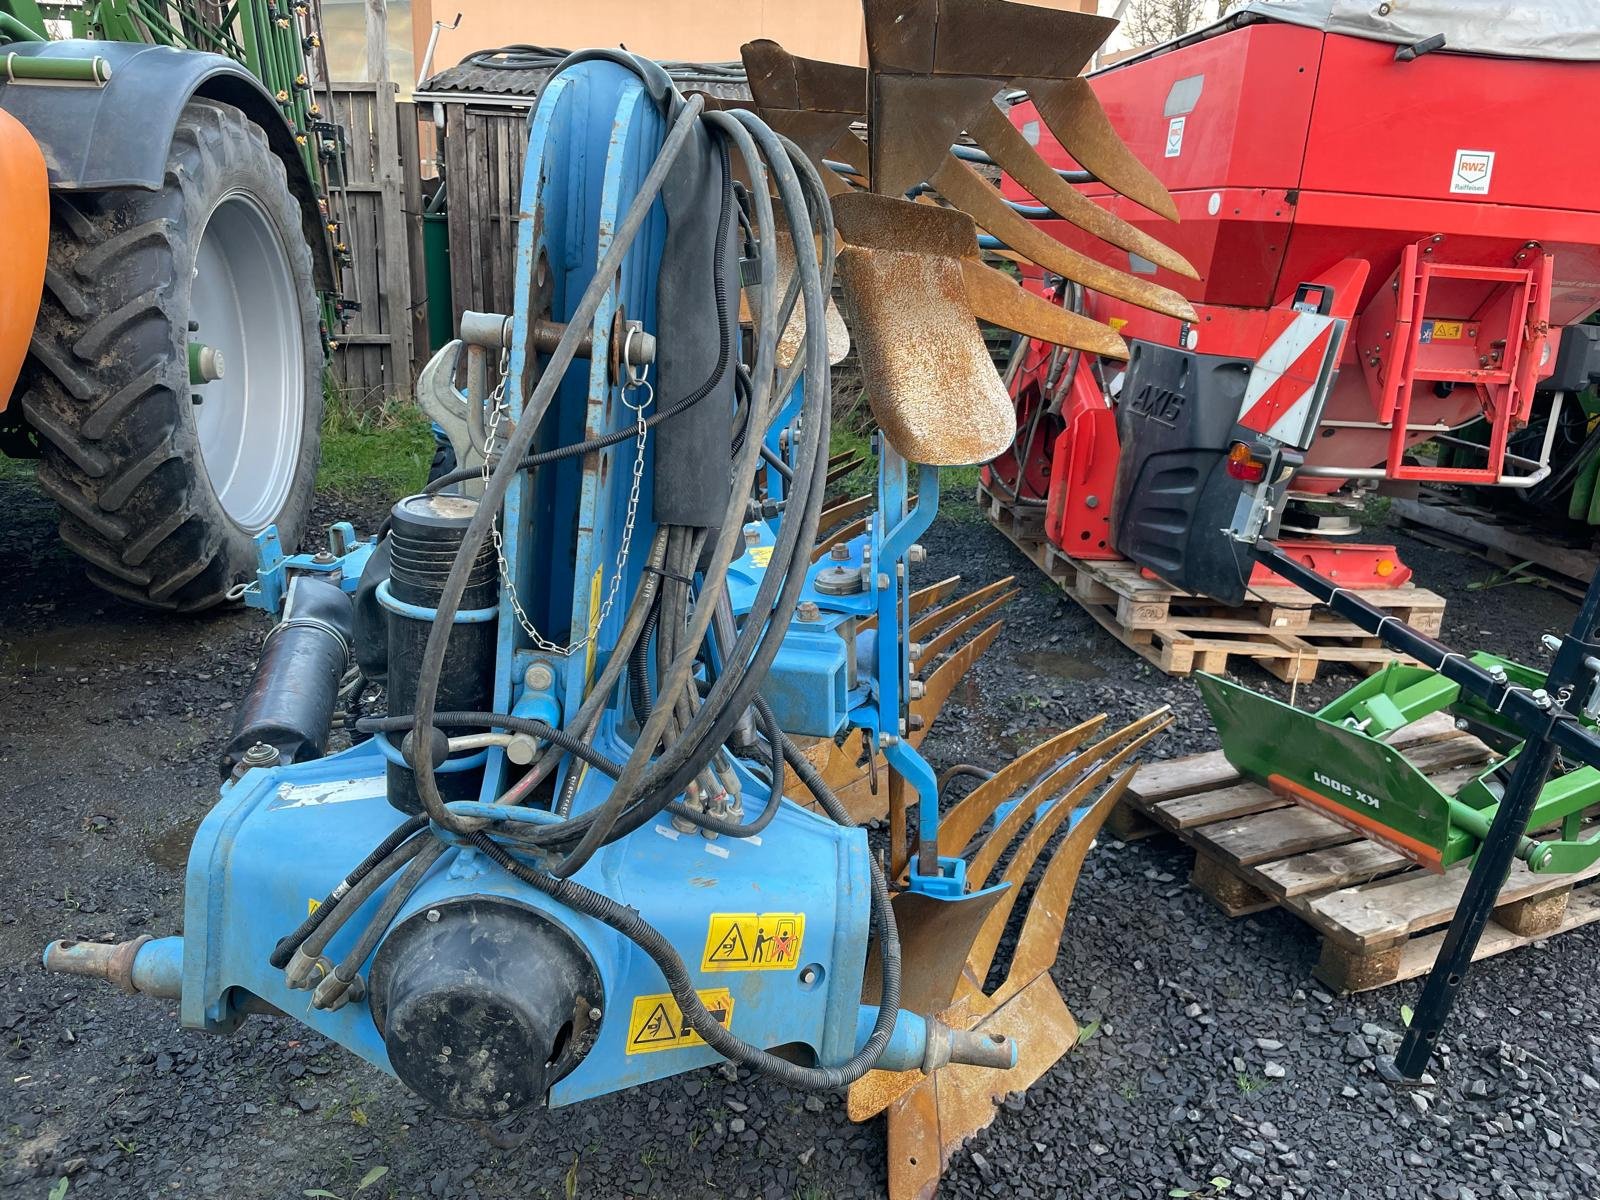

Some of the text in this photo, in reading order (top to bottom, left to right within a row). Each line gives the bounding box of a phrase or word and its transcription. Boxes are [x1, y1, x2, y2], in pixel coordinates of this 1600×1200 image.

[1461, 162, 1486, 172] RWZ
[1131, 383, 1186, 421] AXIS
[1313, 771, 1379, 809] KX 3001
